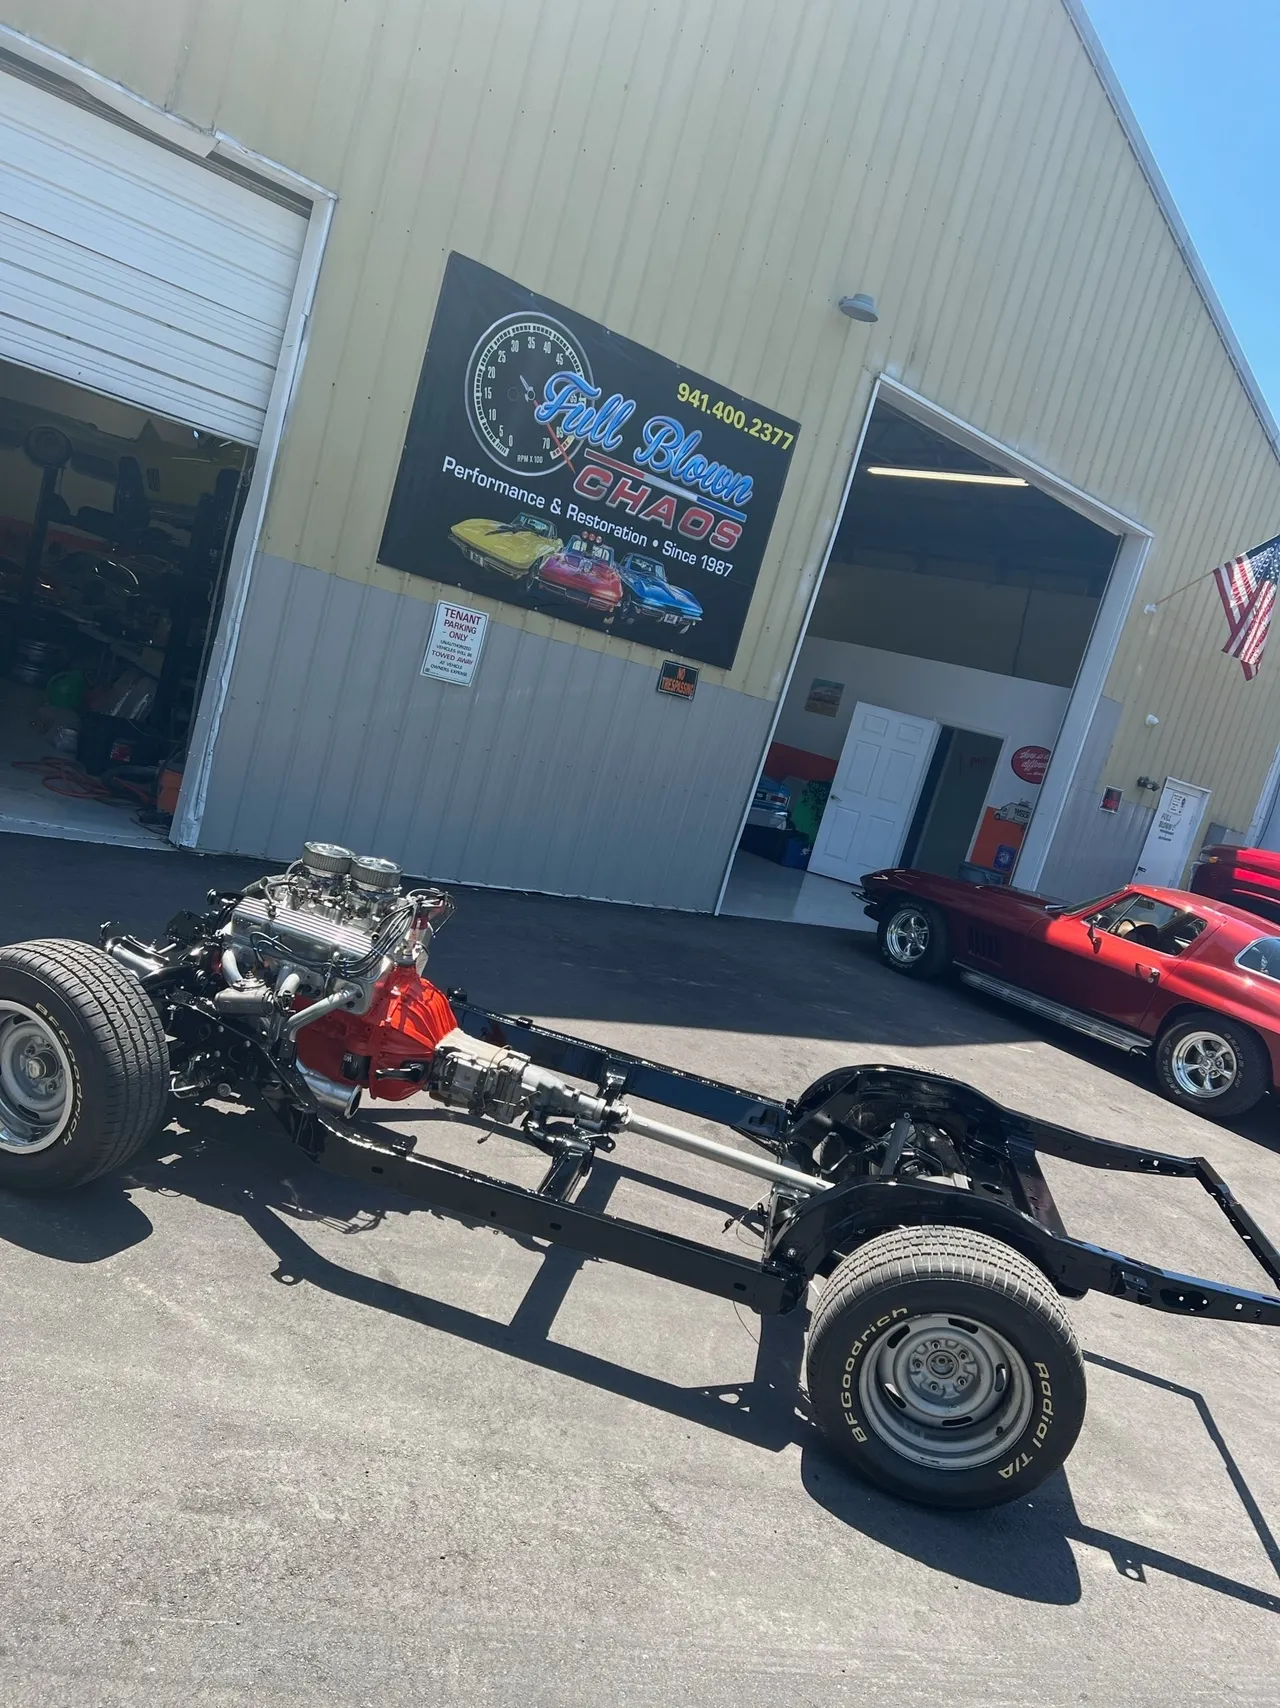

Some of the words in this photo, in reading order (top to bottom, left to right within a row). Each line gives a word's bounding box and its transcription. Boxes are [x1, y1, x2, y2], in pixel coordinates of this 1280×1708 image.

[510, 340, 519, 353] 30
[528, 336, 536, 349] 35
[542, 341, 552, 354] 40
[497, 350, 507, 363] 25
[555, 353, 564, 366] 45
[487, 366, 496, 379] 20
[484, 386, 492, 399] 15
[488, 408, 497, 421] 10
[677, 382, 794, 450] 941.400.2377
[499, 425, 504, 437] 5
[508, 434, 514, 447] 0
[534, 371, 637, 451] Full
[633, 415, 754, 506] Blown
[542, 437, 551, 450] 70
[517, 454, 529, 463] RPM
[533, 455, 544, 464] 100
[573, 464, 743, 551] CHAOS
[442, 456, 546, 509] Performance
[550, 498, 562, 515] &
[566, 503, 648, 548] Restoration
[662, 540, 697, 566] Since
[701, 554, 734, 578] 1987
[444, 607, 482, 626] TENANT
[443, 619, 477, 635] PARKING
[448, 630, 469, 642] ONLY
[436, 644, 457, 654] VEHICLES
[440, 639, 472, 652] UNAUTHORIZED
[432, 649, 456, 661] TOWED
[456, 656, 474, 665] AWAY
[446, 661, 463, 670] VEHICLE
[36, 1002, 82, 1146] BFGoodrich
[841, 1306, 908, 1443] BFGoodrich
[1033, 1361, 1055, 1449] Radial
[997, 1453, 1033, 1479] T/A
